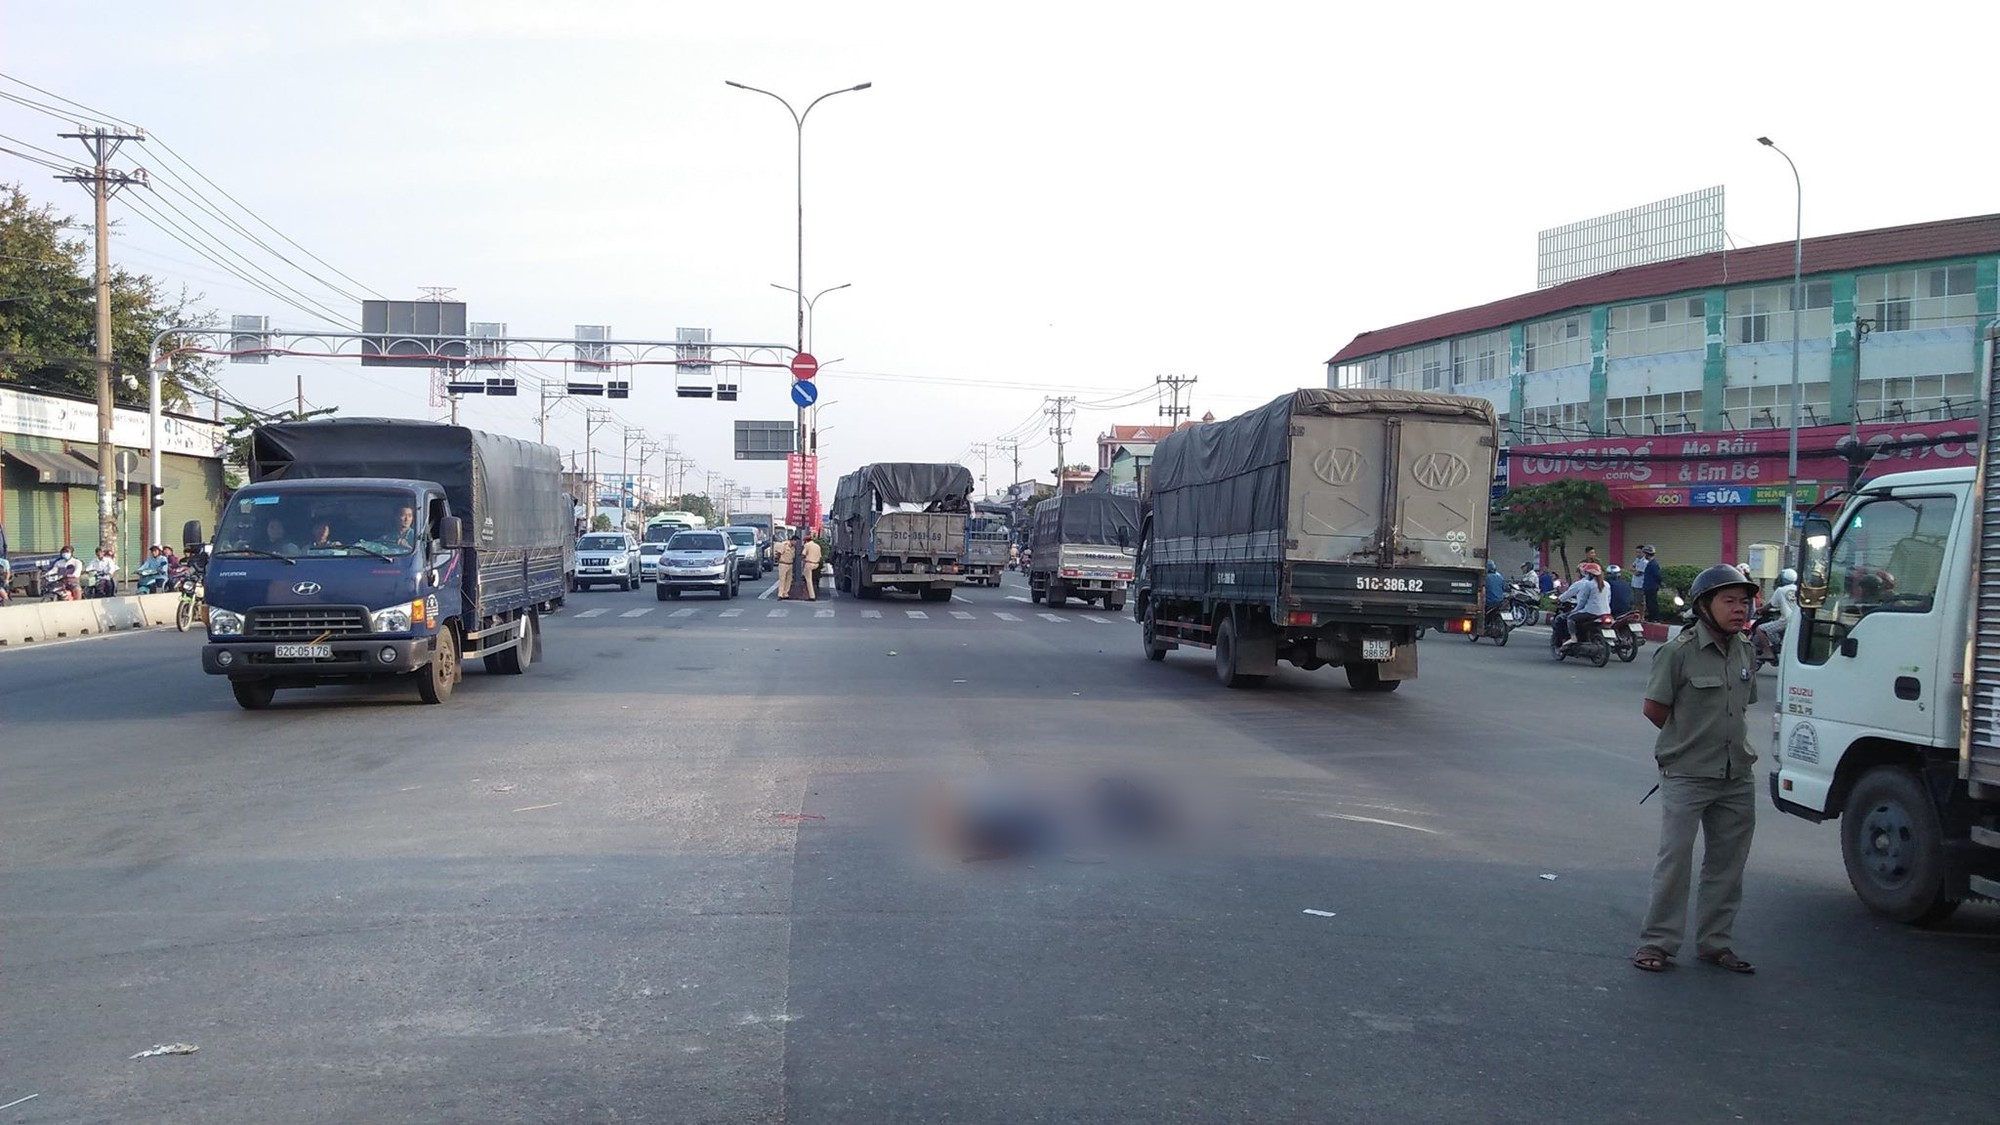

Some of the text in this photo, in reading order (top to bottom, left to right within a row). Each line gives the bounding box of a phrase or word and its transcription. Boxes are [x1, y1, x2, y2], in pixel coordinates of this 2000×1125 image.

[1679, 460, 1760, 481] & Em Bé
[1706, 487, 1741, 504] SỮA
[1356, 576, 1424, 592] 51C-386.82
[1789, 686, 1813, 697] ISUZU
